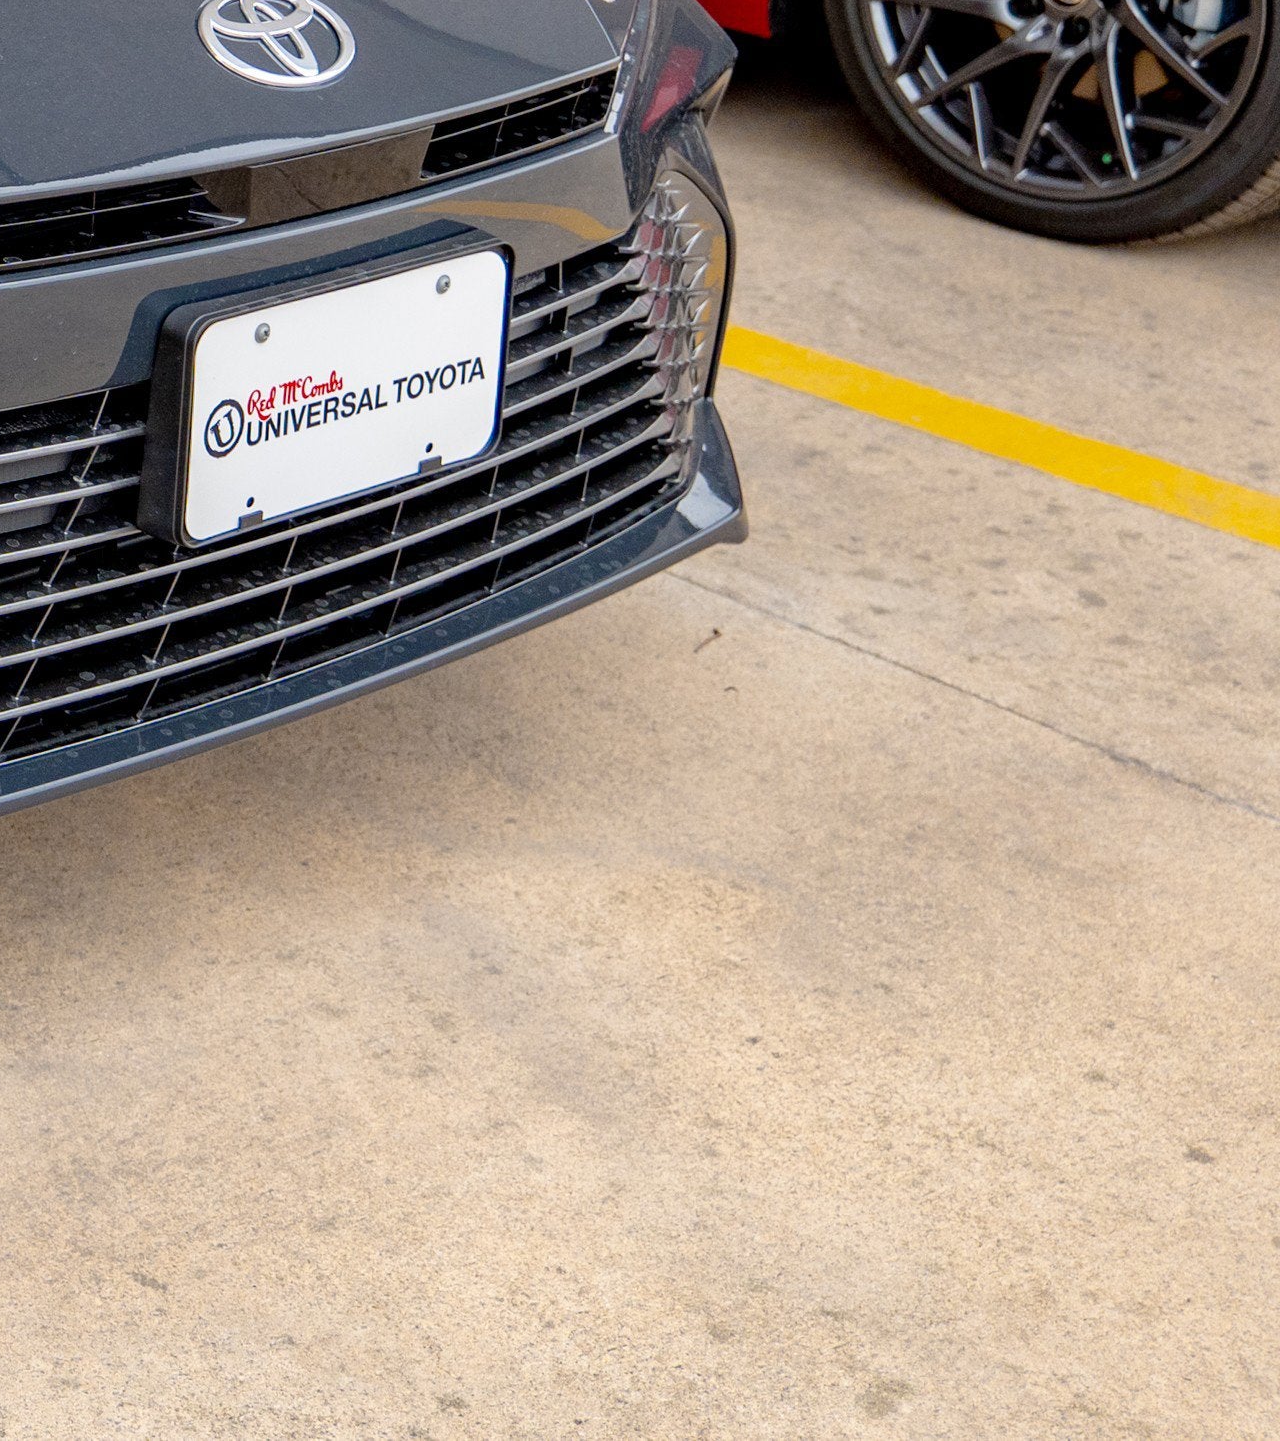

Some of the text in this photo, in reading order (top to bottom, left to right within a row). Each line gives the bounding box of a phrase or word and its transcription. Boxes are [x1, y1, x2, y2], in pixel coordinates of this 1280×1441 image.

[246, 357, 485, 446] UNIVERSAL TOYOTA
[247, 370, 344, 421] Red McCombs
